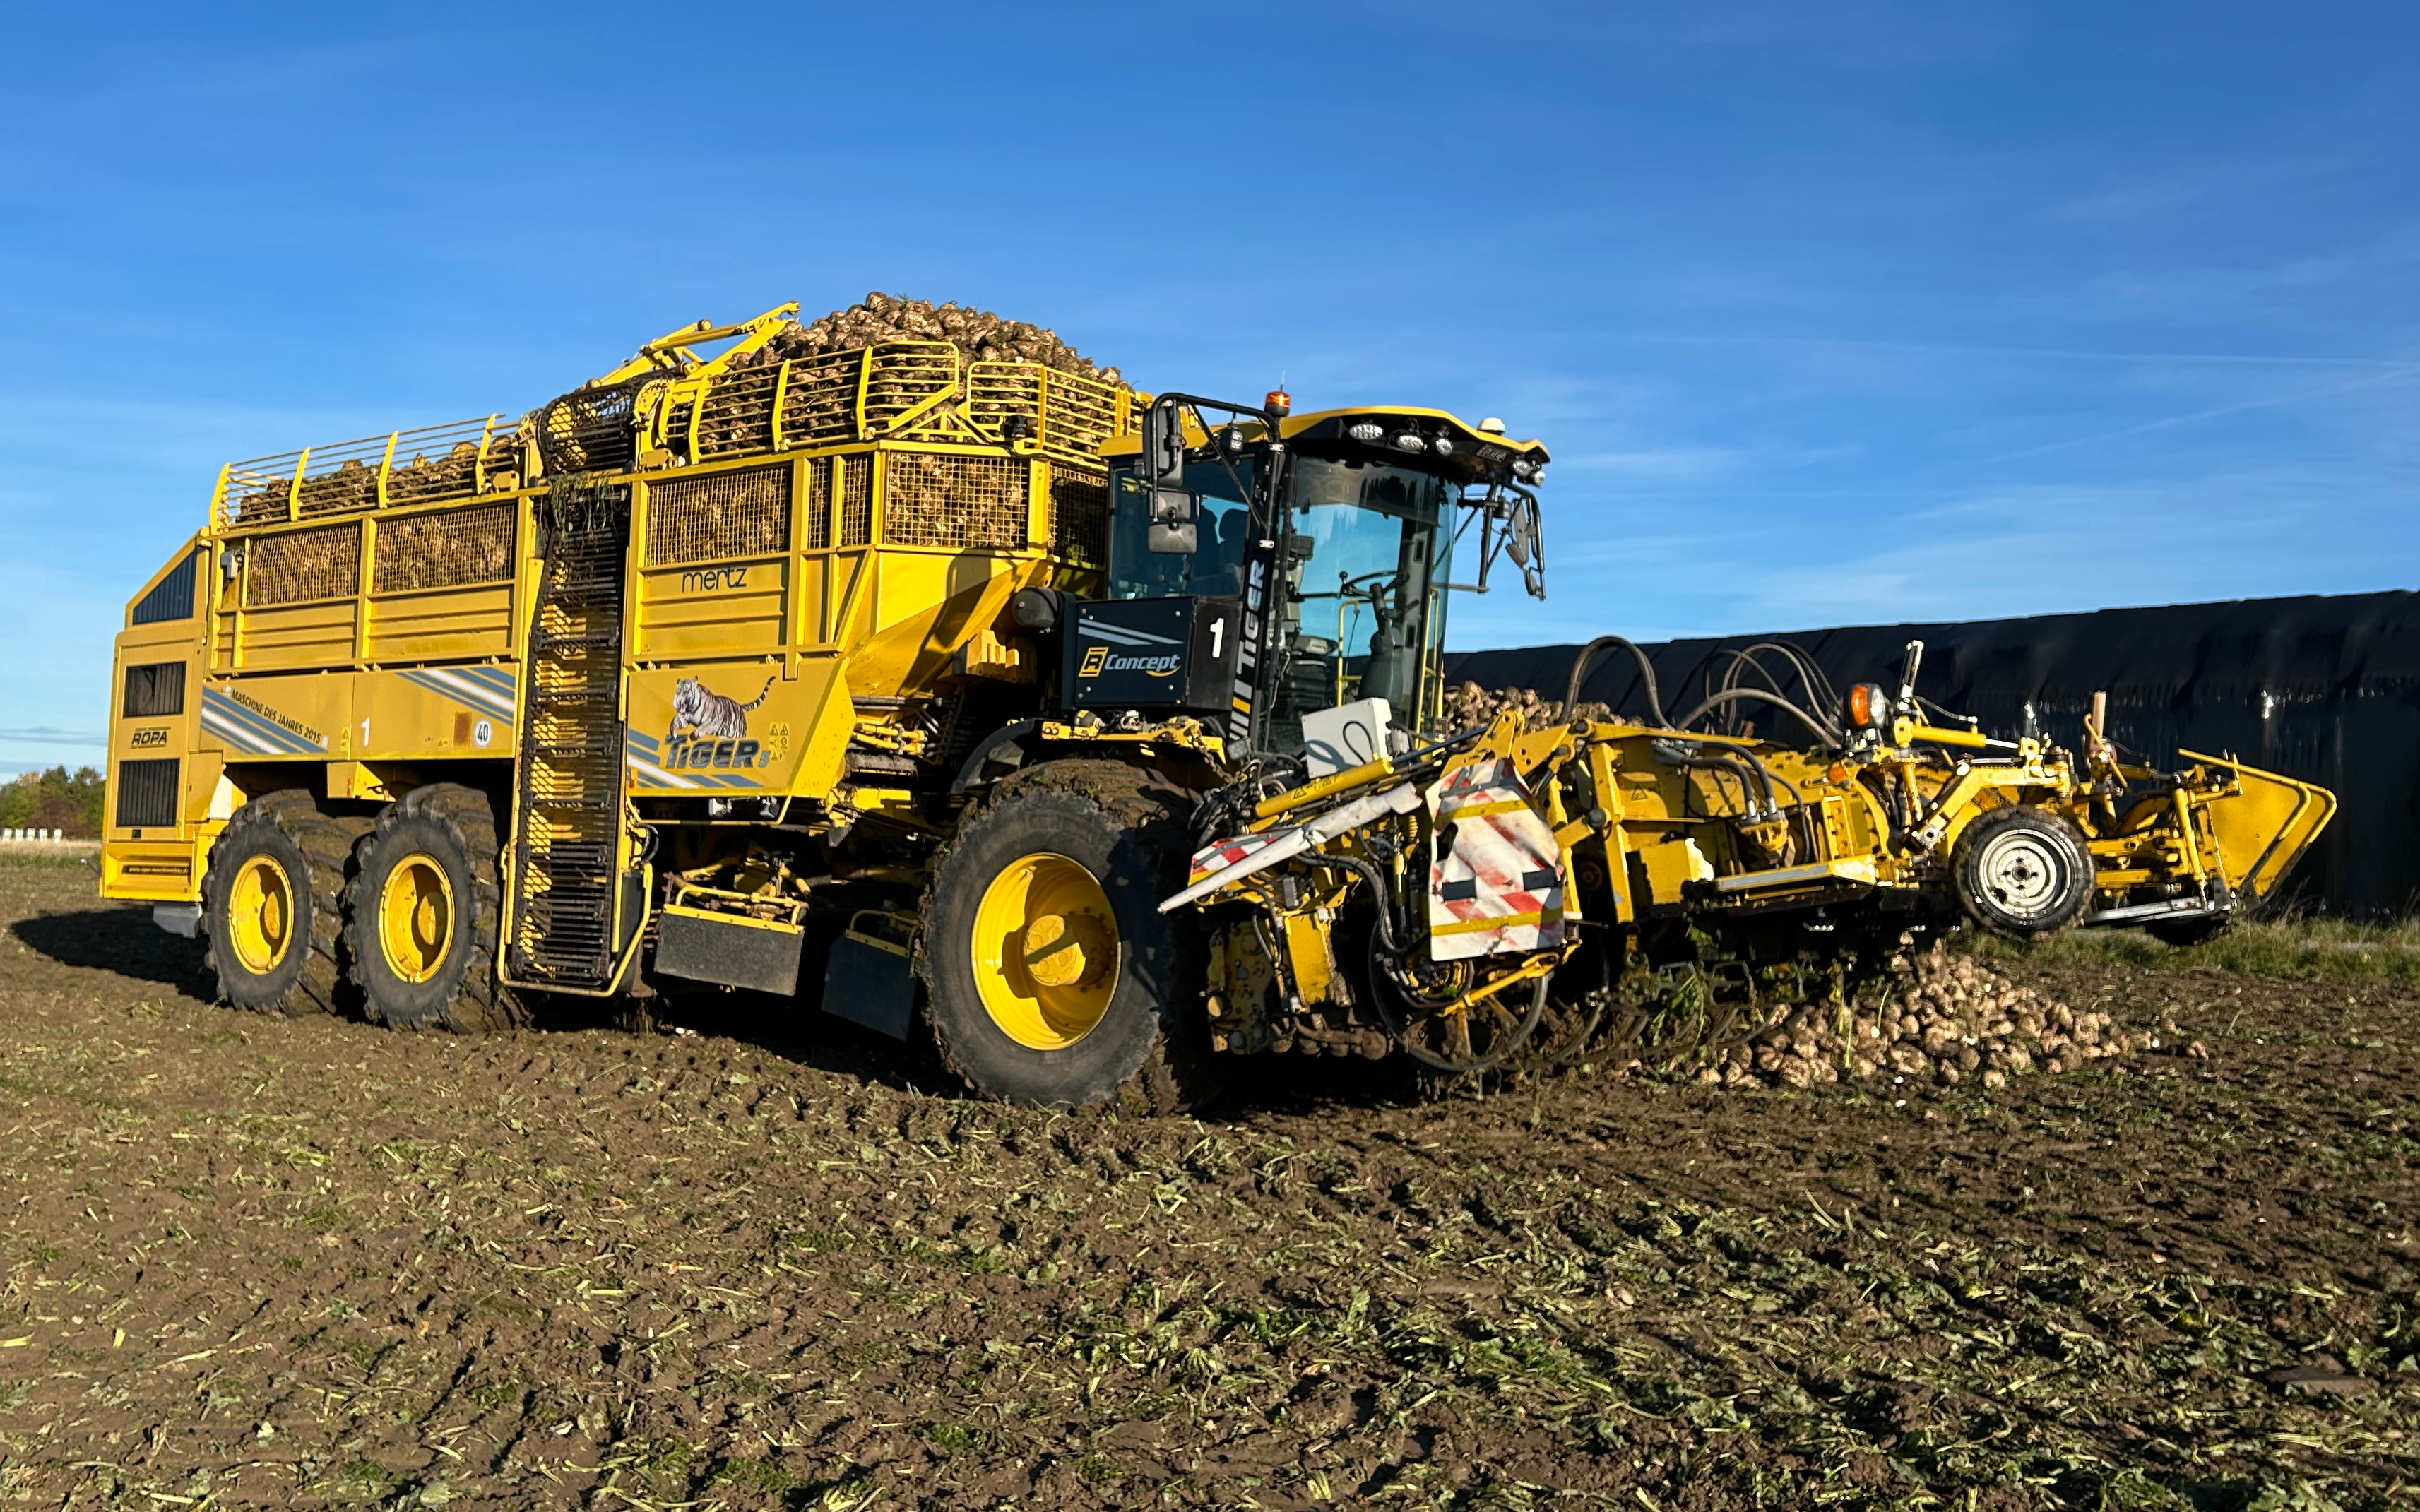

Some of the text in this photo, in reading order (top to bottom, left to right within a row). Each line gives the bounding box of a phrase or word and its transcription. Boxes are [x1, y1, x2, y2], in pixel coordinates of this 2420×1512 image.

[682, 565, 747, 593] mertz
[1209, 617, 1224, 658] 1
[1105, 654, 1180, 672] Concept
[232, 689, 322, 744] MASCHINE DES JAHRES 2015
[131, 731, 167, 745] ROPA
[361, 716, 370, 746] 1
[477, 724, 489, 742] 40
